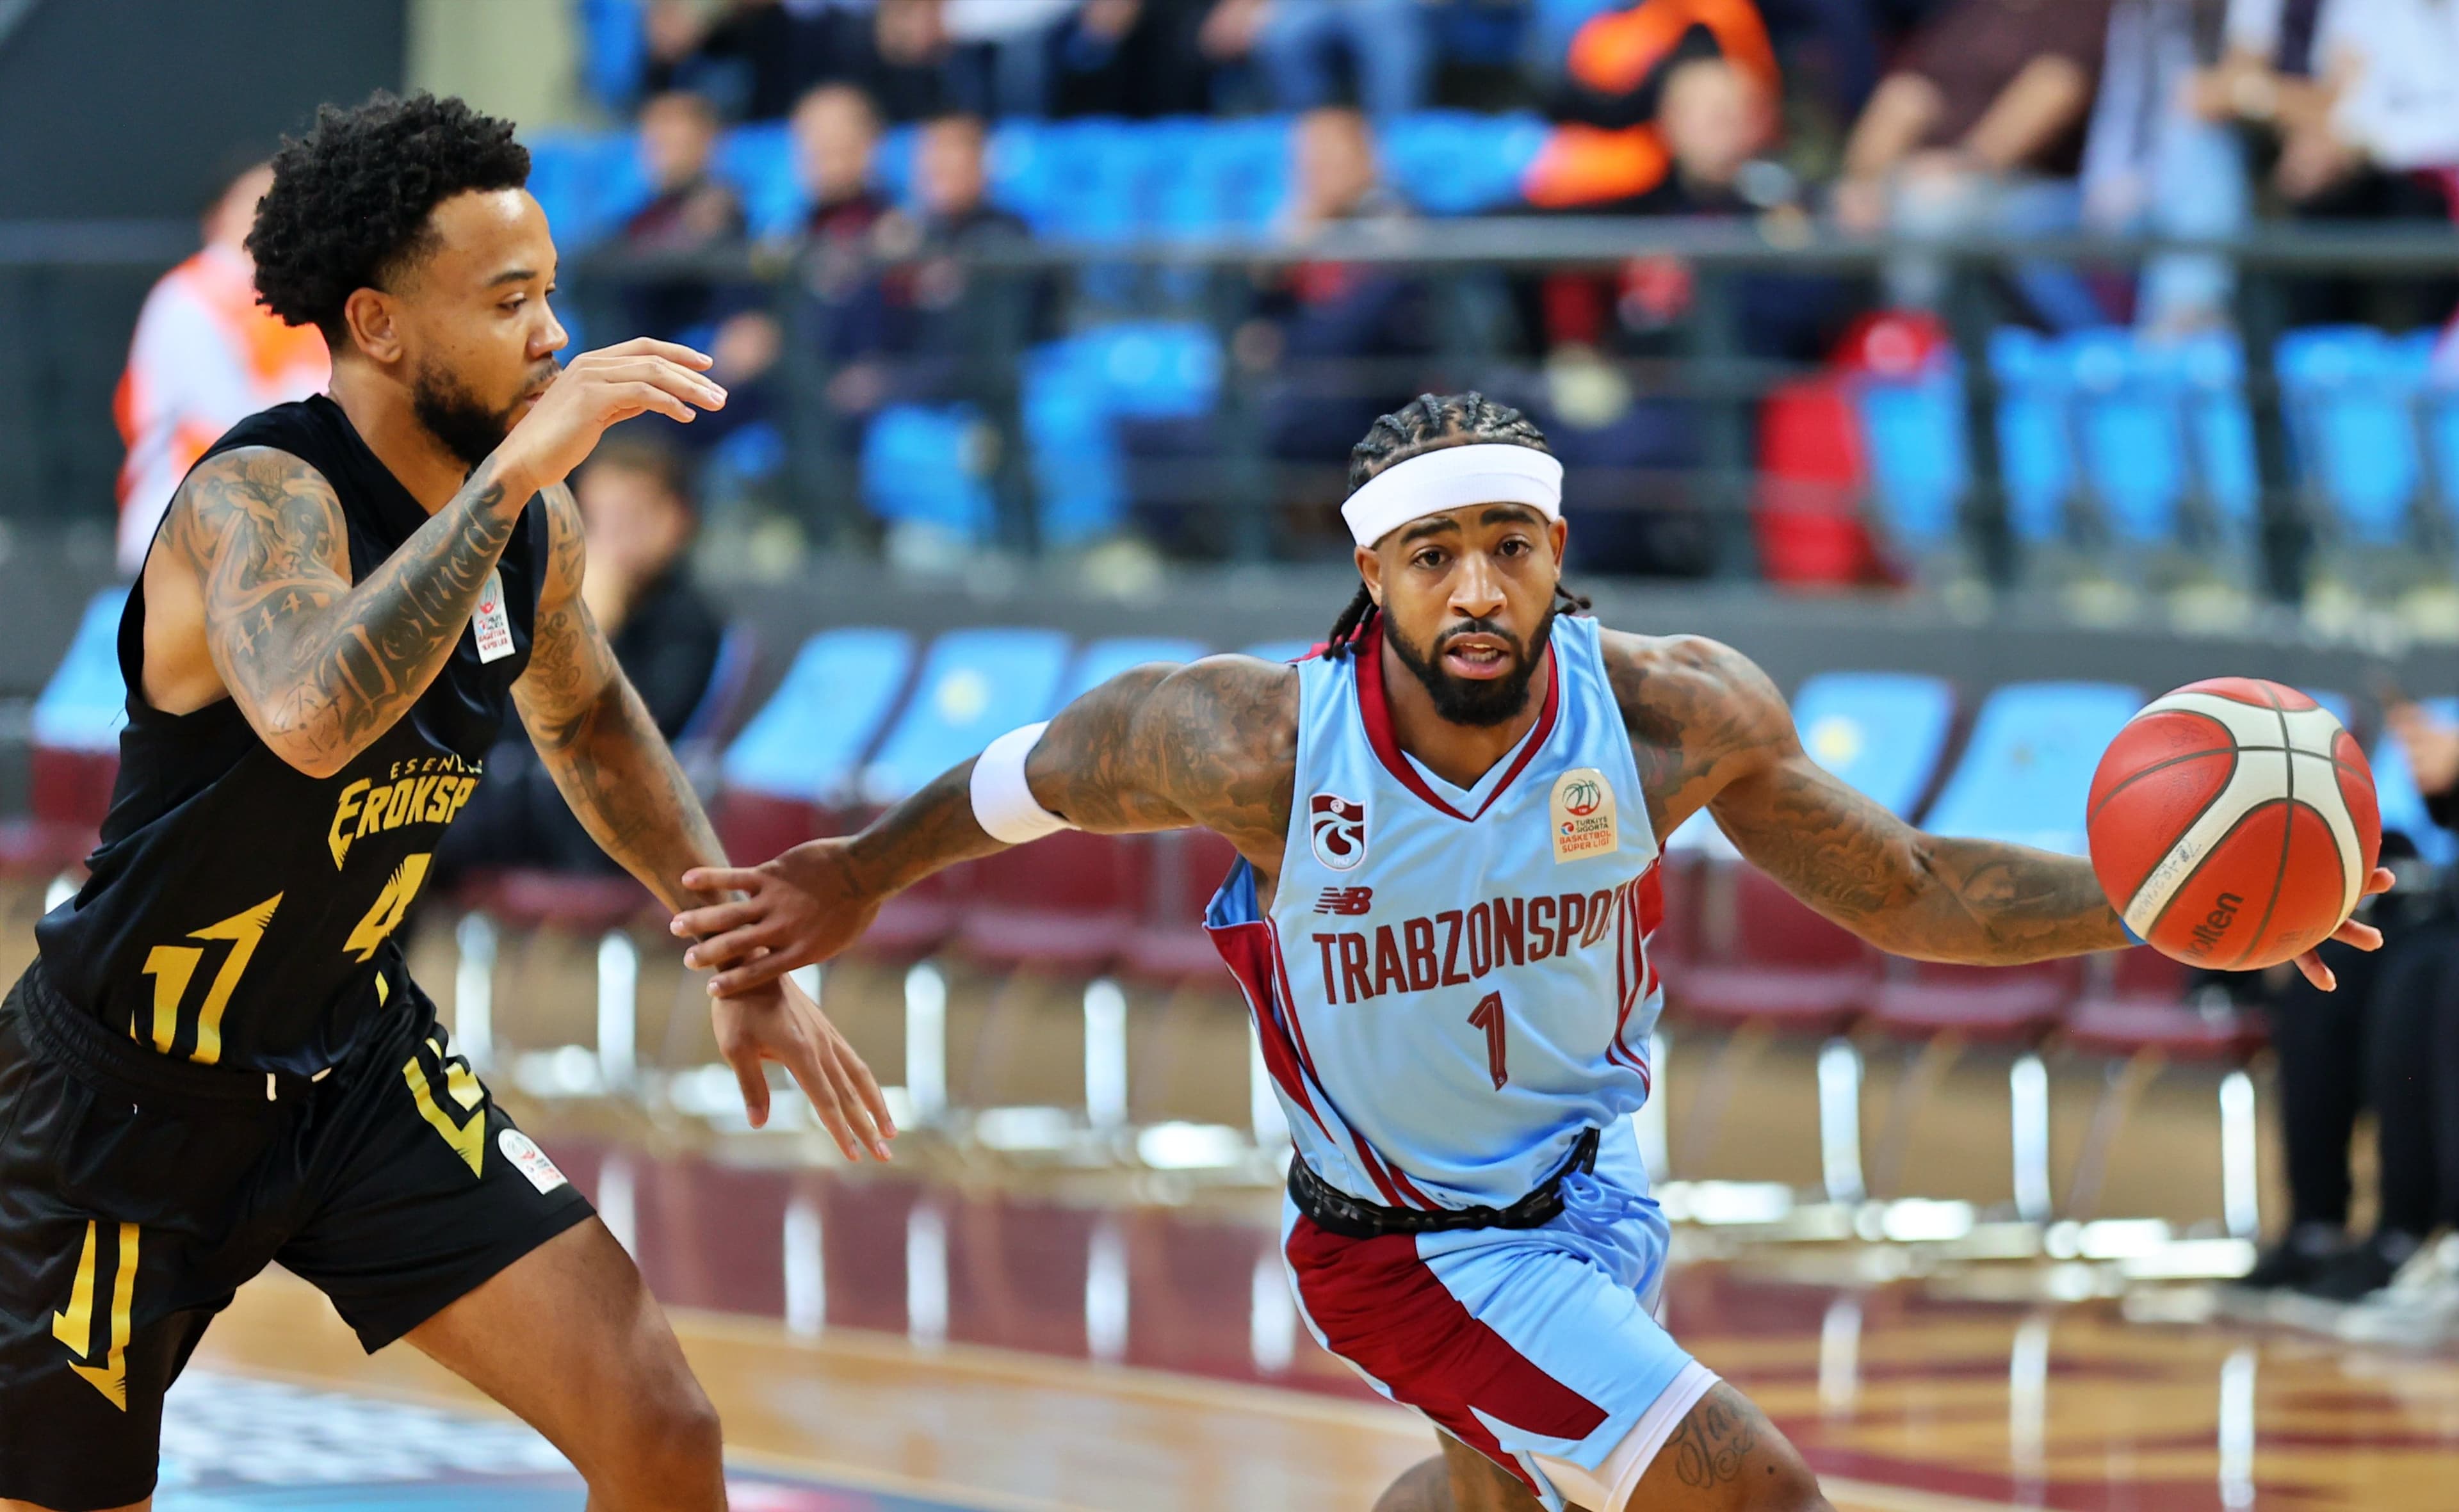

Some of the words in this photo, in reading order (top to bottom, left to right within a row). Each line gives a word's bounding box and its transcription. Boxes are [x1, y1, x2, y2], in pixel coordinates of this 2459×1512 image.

[328, 776, 481, 872] EROKSP
[343, 852, 432, 963] 4
[1467, 990, 1507, 1091] 1
